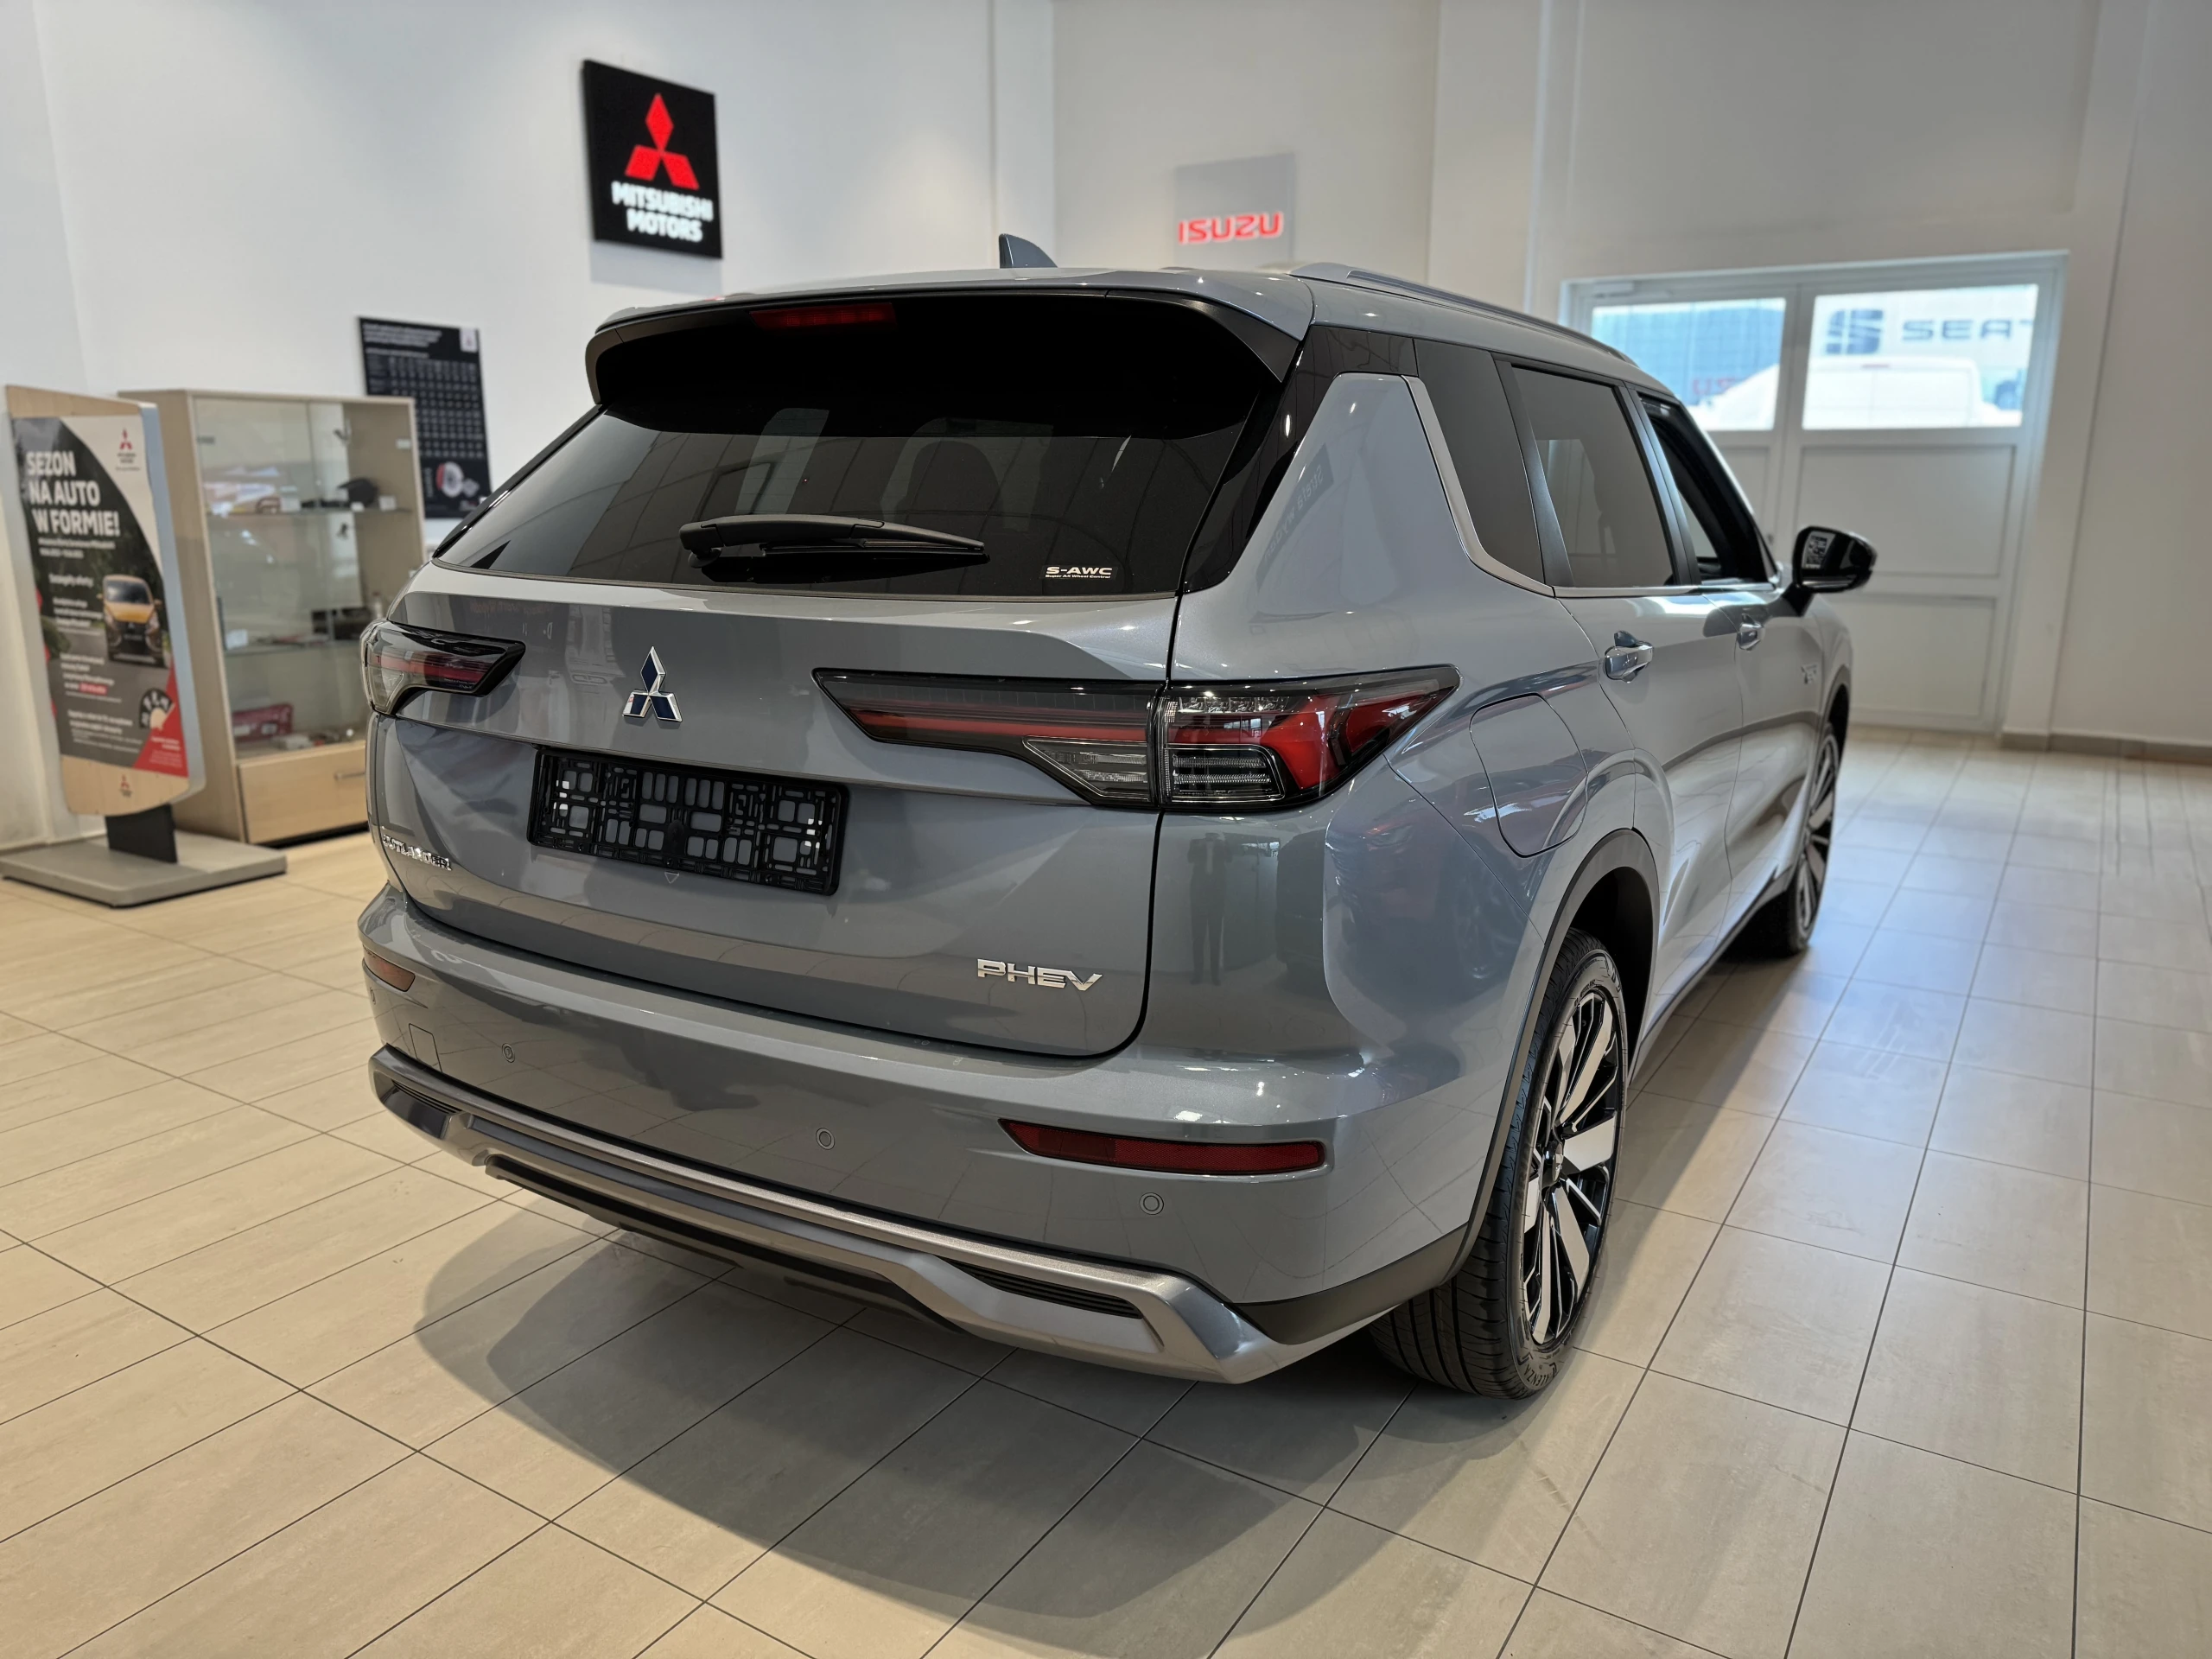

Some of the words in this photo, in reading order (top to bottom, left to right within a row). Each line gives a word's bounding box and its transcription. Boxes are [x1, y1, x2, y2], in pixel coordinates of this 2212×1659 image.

[611, 181, 714, 222] MITSUBISHI
[626, 208, 703, 242] MOTORS
[1178, 212, 1283, 245] ISUZU
[26, 450, 76, 476] SEZON
[29, 480, 53, 505] NA
[54, 480, 101, 506] AUTO
[32, 508, 49, 533] W
[50, 509, 121, 537] FORMIE!
[1046, 566, 1113, 575] S-AWC
[977, 958, 1103, 991] PHEV
